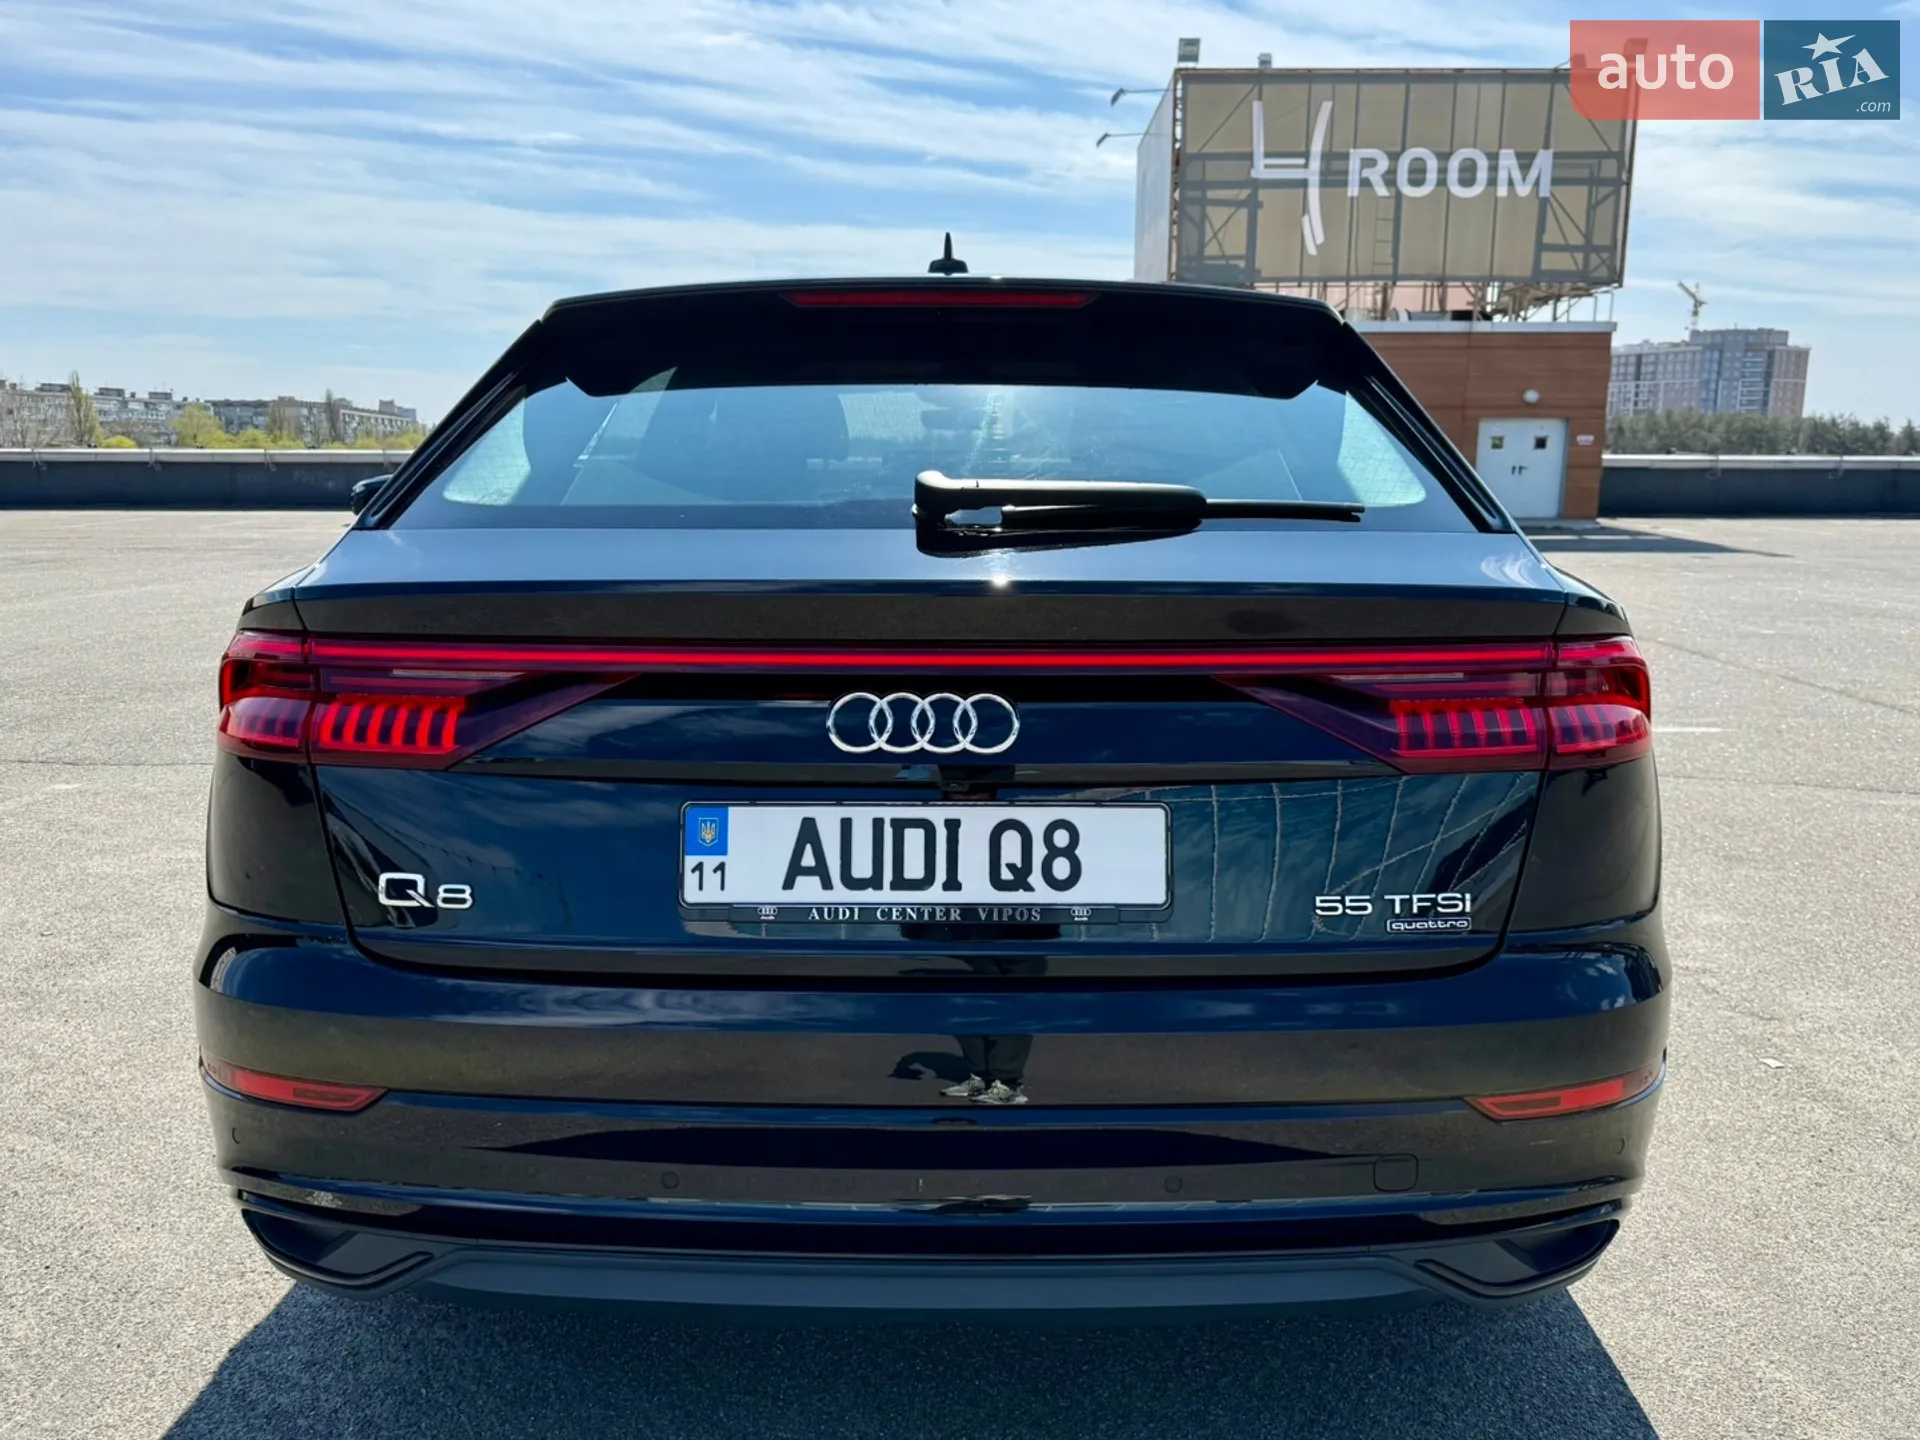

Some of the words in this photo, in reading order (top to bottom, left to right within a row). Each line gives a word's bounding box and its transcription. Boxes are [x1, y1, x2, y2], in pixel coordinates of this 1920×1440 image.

[1347, 147, 1554, 199] ROOM
[781, 817, 963, 892] AUDI
[988, 818, 1083, 892] Q8
[378, 872, 474, 910] Q8
[690, 861, 727, 892] 11
[808, 907, 860, 922] AUDI
[875, 907, 962, 922] CENTER
[977, 907, 1042, 922] VIPOS
[1315, 895, 1374, 916] 55
[1384, 892, 1472, 915] TFSI
[1391, 919, 1469, 931] quattro
